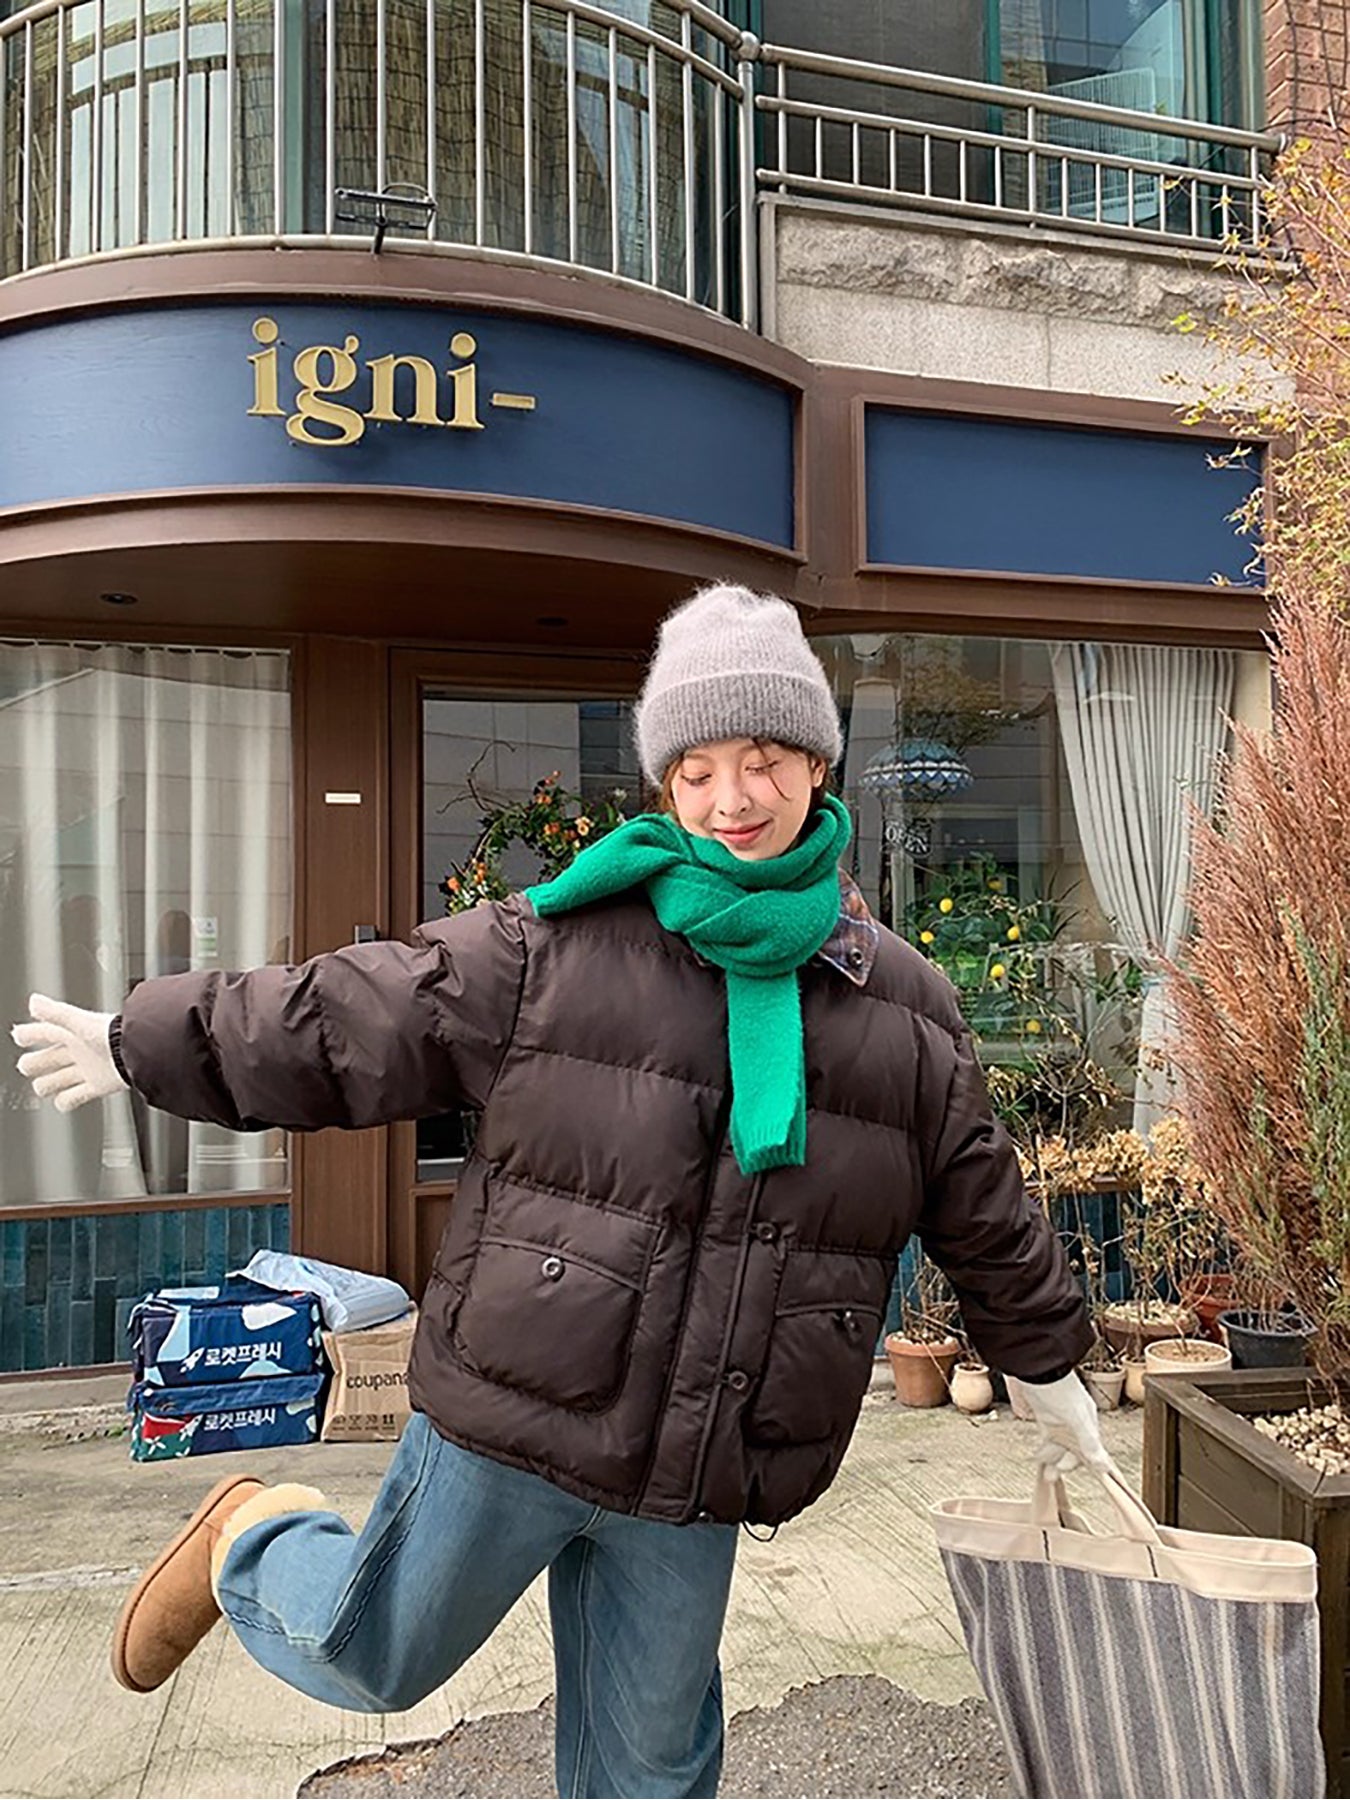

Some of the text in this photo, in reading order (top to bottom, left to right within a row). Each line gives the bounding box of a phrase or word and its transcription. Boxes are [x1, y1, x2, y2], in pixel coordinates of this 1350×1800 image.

[247, 317, 536, 446] igni-
[204, 1341, 282, 1366] 로켓프레시
[203, 1407, 276, 1431] 로켓프레시
